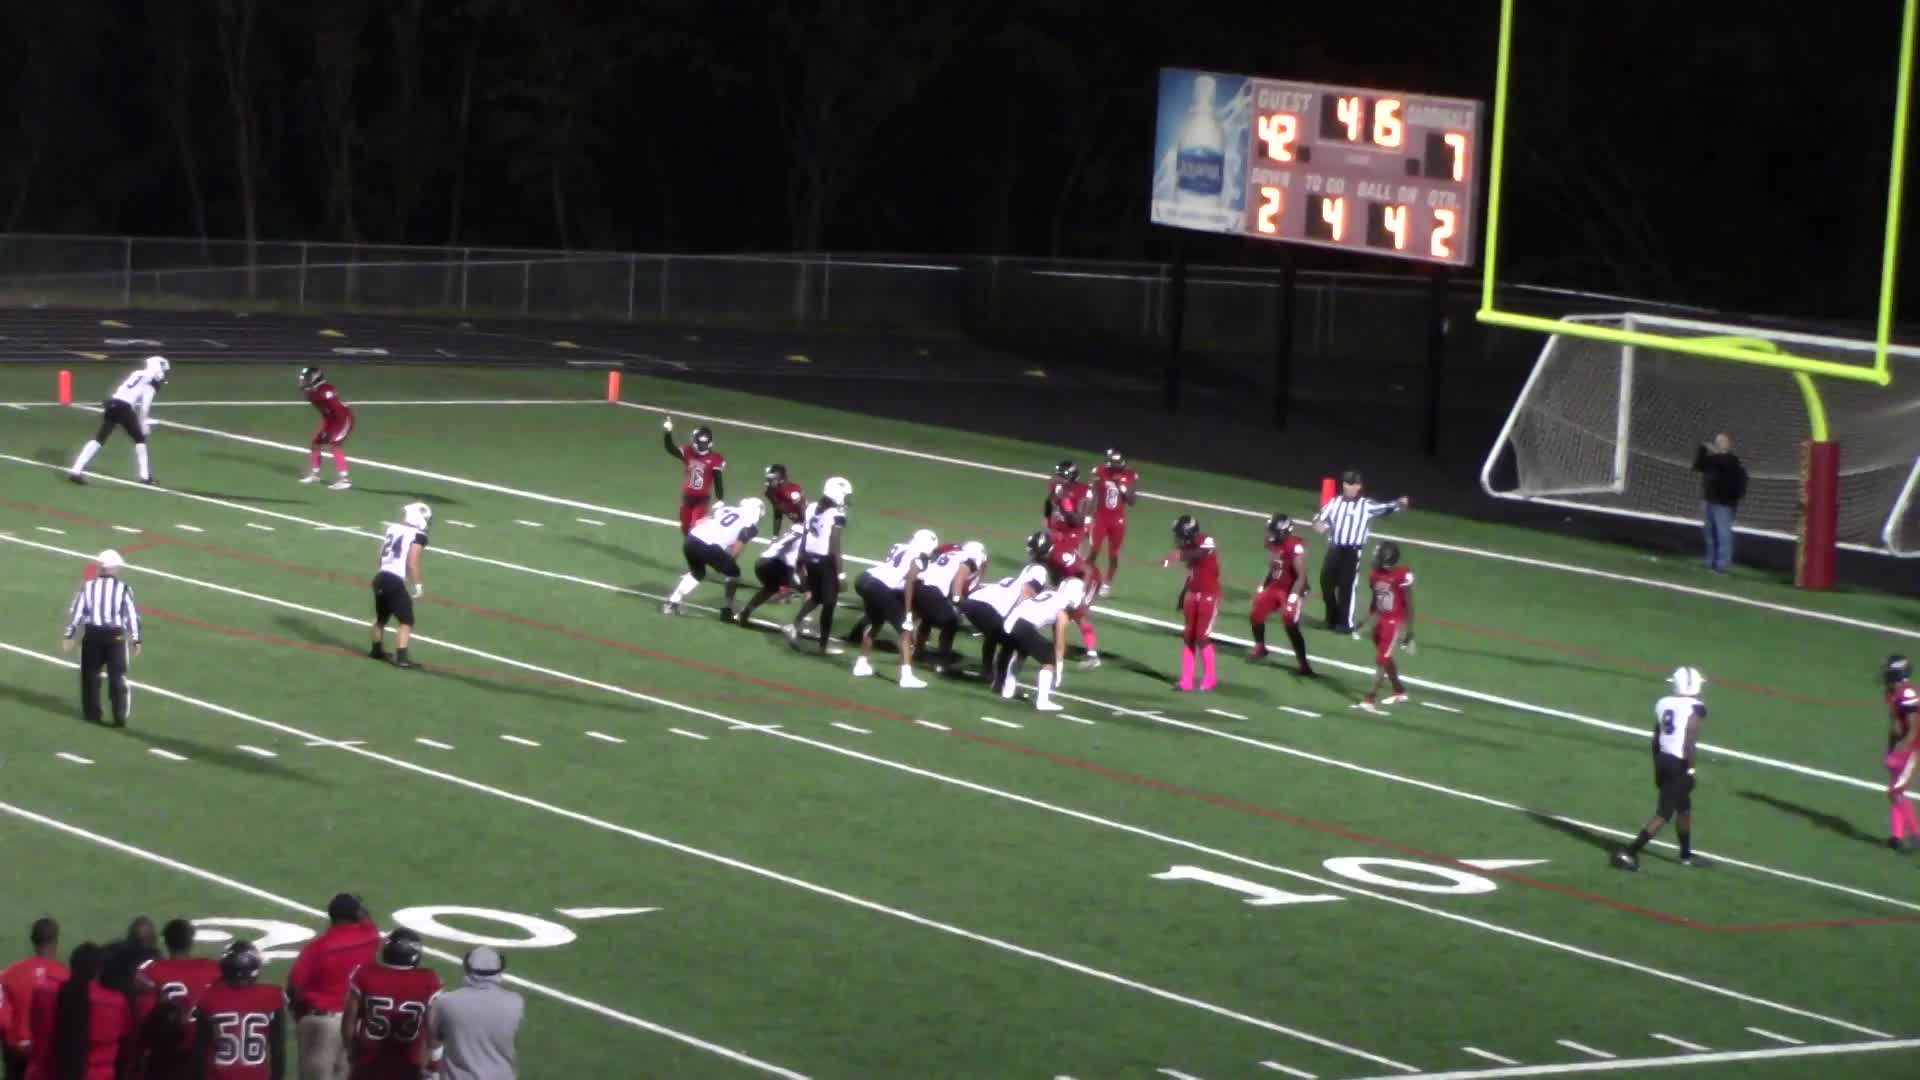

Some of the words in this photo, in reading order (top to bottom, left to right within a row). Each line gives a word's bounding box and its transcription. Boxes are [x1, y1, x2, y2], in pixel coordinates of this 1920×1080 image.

[1257, 88, 1312, 112] GUEST
[1257, 113, 1297, 162] 42
[1443, 131, 1466, 182] 7
[1257, 186, 1280, 234] 2
[1322, 197, 1344, 241] 4
[1384, 205, 1406, 250] 4
[1430, 208, 1455, 258] 2
[382, 532, 405, 559] 24
[1151, 855, 1498, 906] 10
[212, 1011, 270, 1066] 56
[365, 995, 427, 1042] 53
